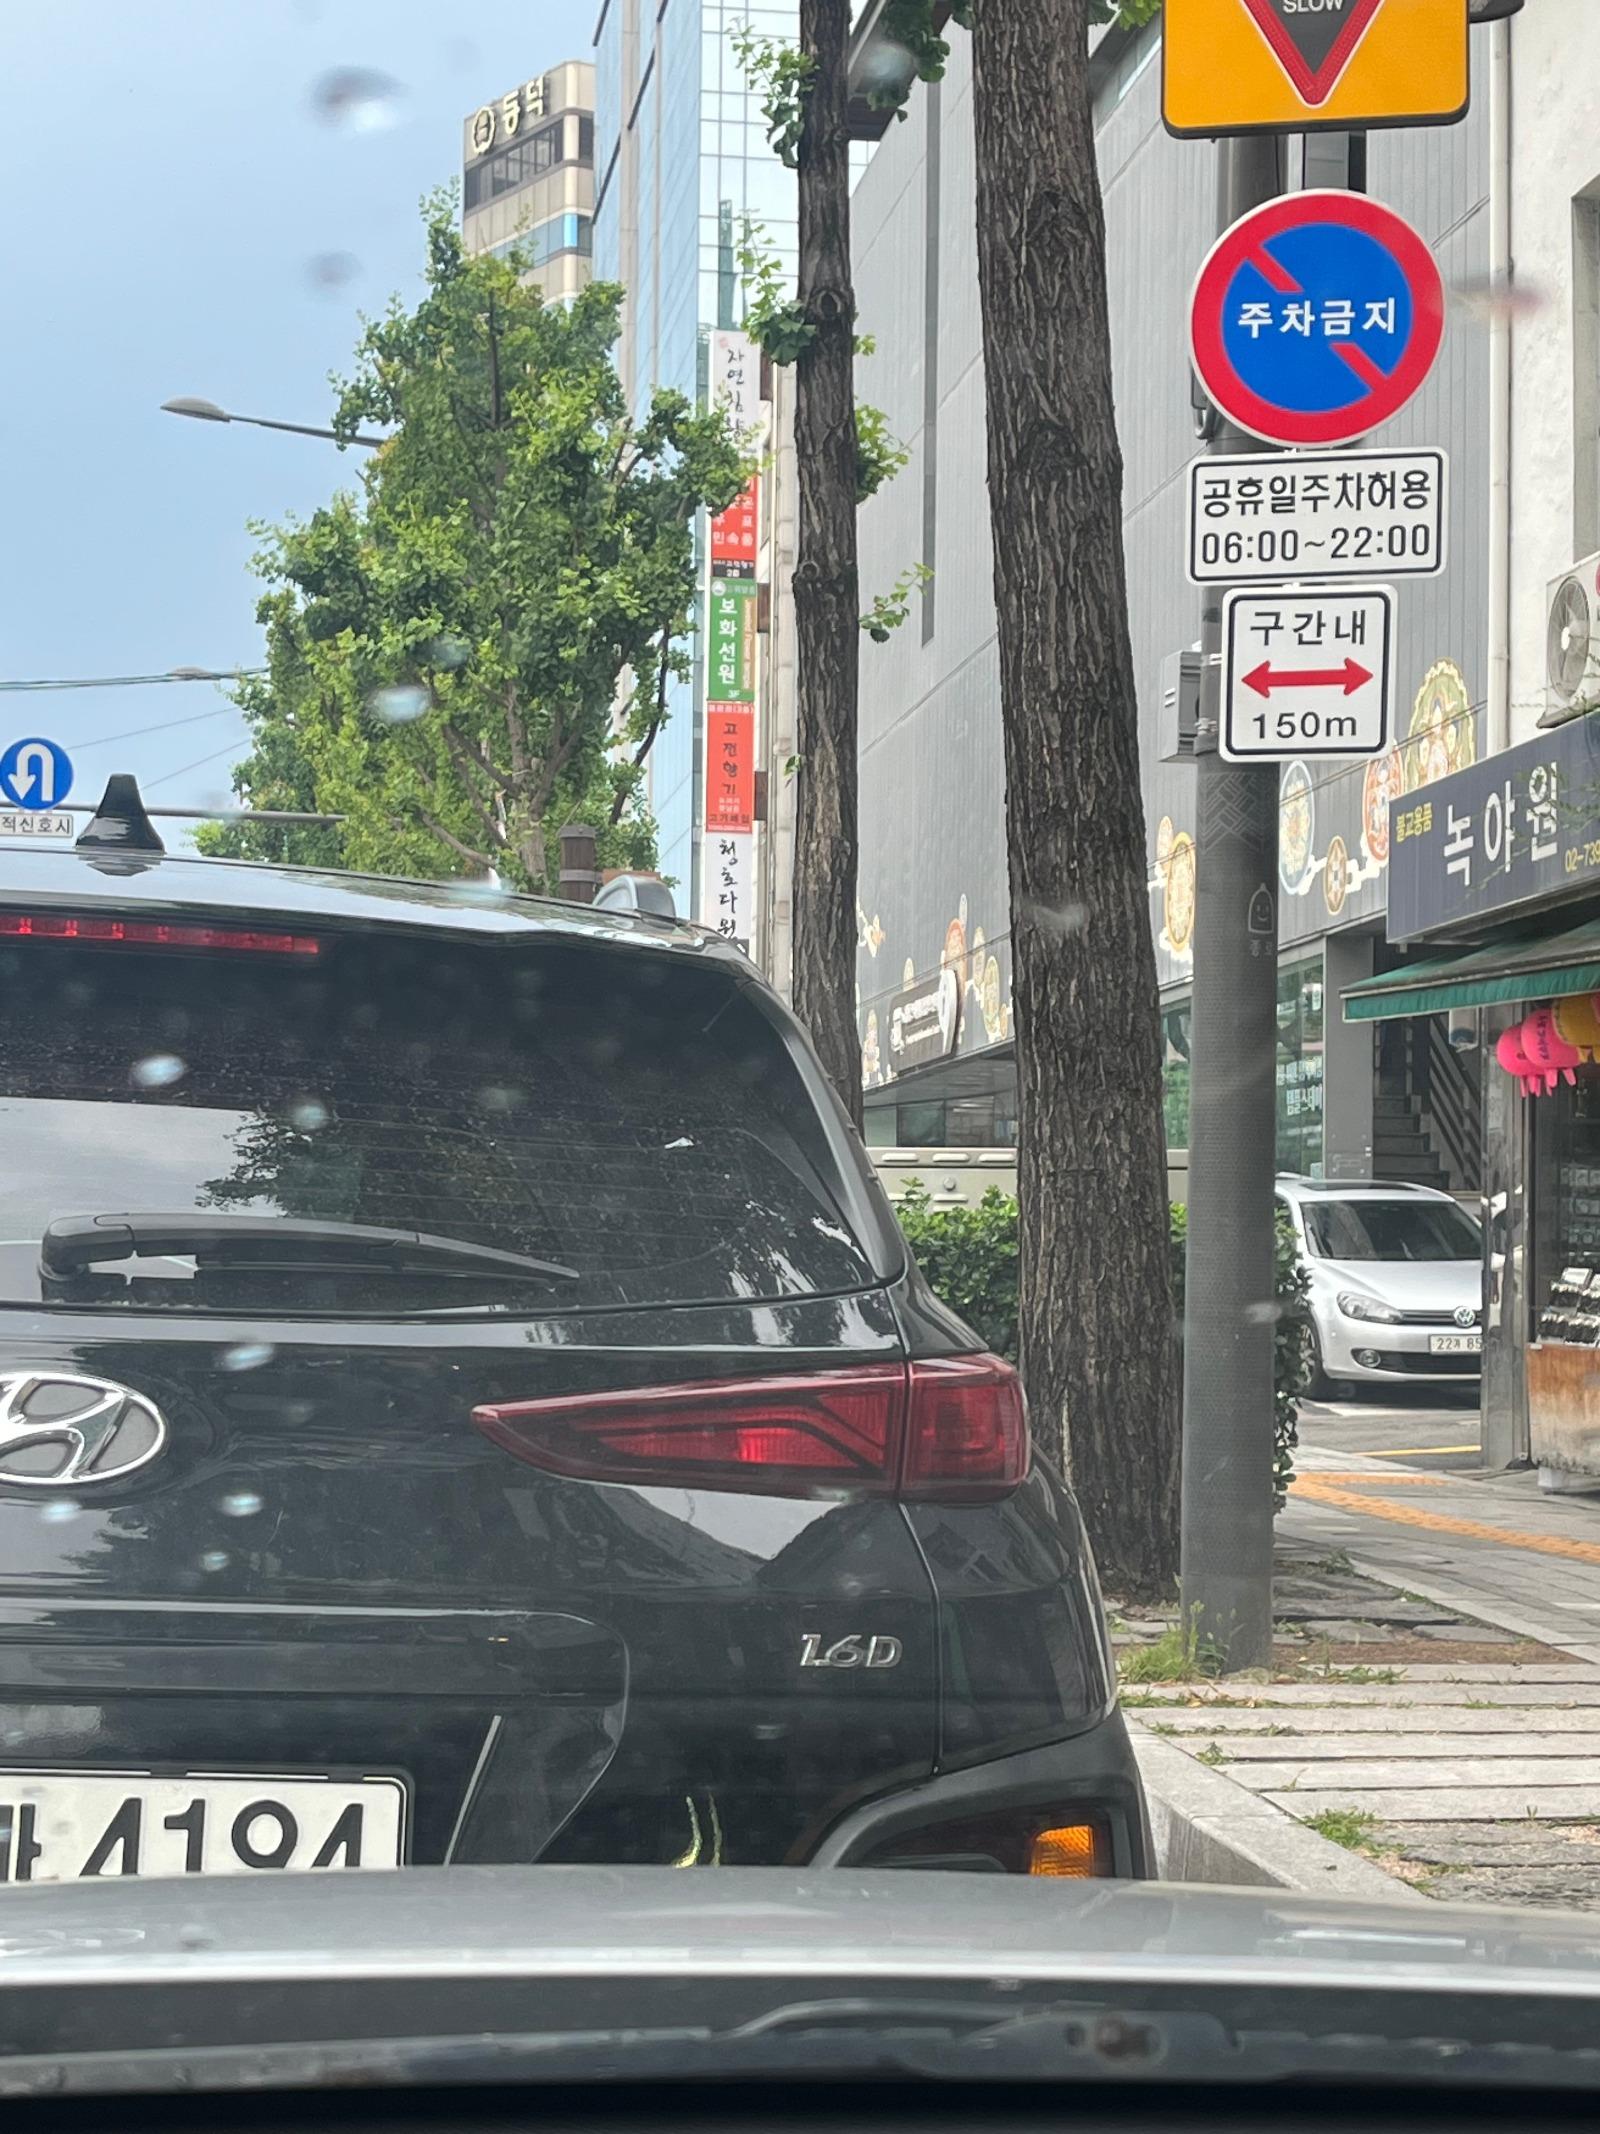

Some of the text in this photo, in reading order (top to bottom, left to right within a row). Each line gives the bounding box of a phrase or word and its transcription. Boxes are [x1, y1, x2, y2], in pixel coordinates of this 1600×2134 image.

[1283, 0, 1342, 13] SLOW
[502, 74, 545, 135] 동덕
[1238, 297, 1395, 338] 주차금지
[1203, 469, 1431, 518] 공휴일주차허용
[1202, 523, 1430, 564] 06:00~22:00
[718, 598, 737, 684] 보화선원
[1250, 609, 1366, 646] 구간내
[1253, 711, 1357, 739] 150m
[2, 816, 70, 834] 적신호시
[1396, 801, 1432, 843] 불교용품
[1443, 762, 1558, 887] 녹야원
